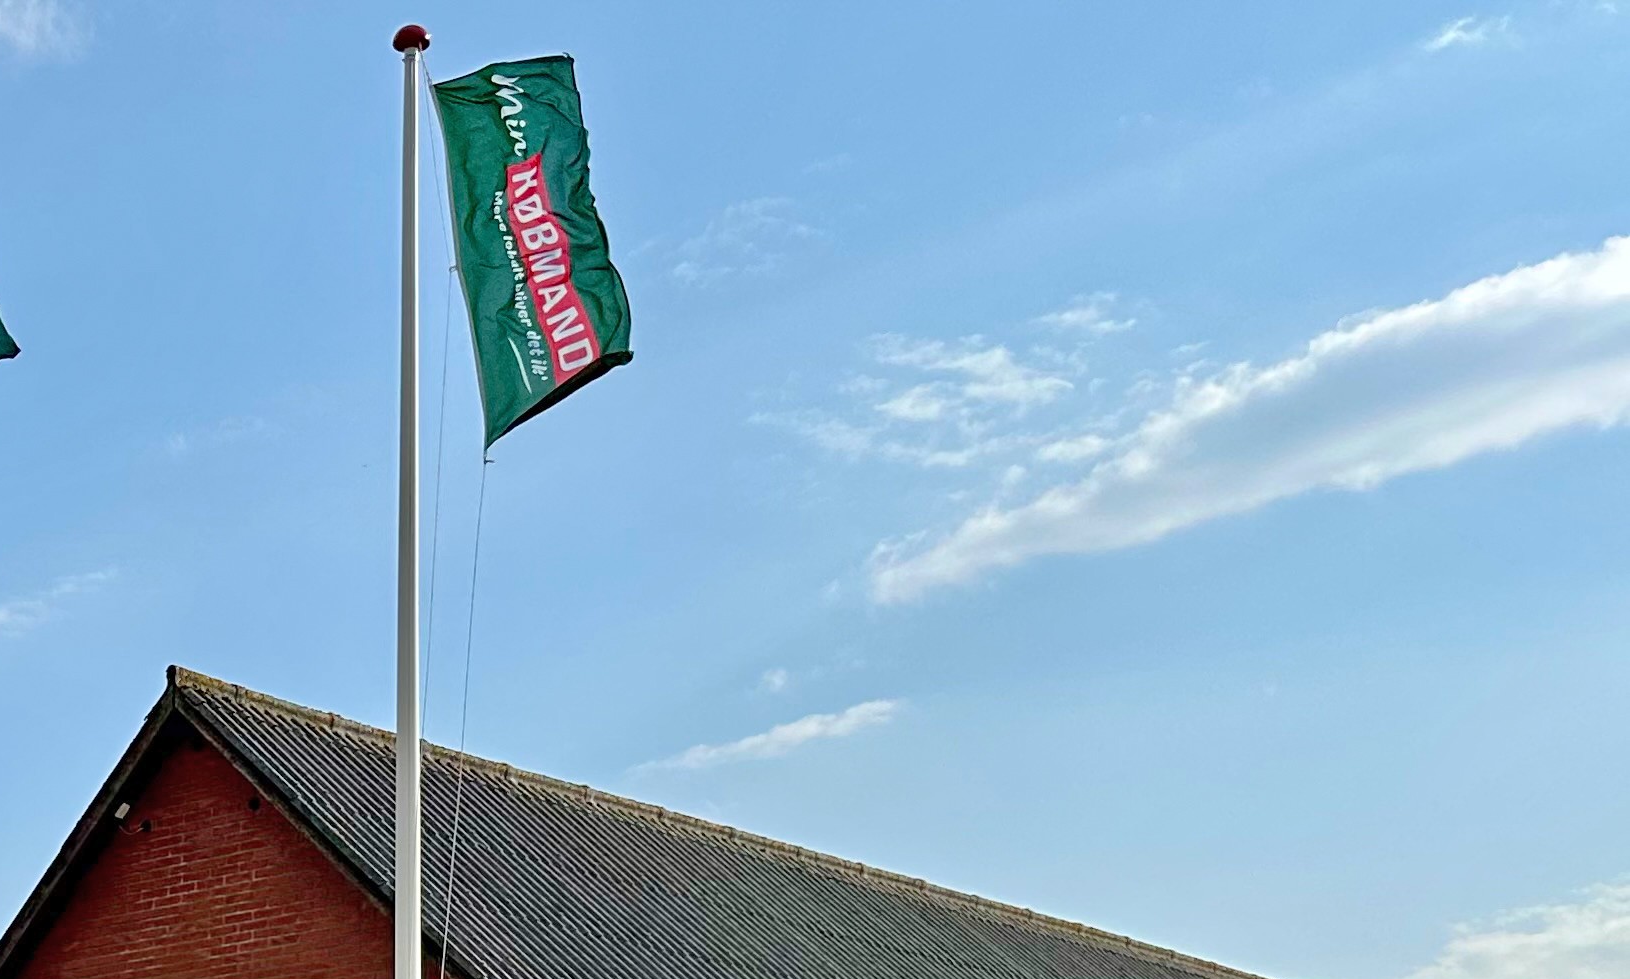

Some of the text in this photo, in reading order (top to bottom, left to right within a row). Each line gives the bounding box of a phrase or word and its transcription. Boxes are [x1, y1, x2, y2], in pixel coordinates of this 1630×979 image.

[493, 191, 507, 232] Mere
[526, 330, 544, 357] det
[512, 166, 595, 374] KØBMAND
